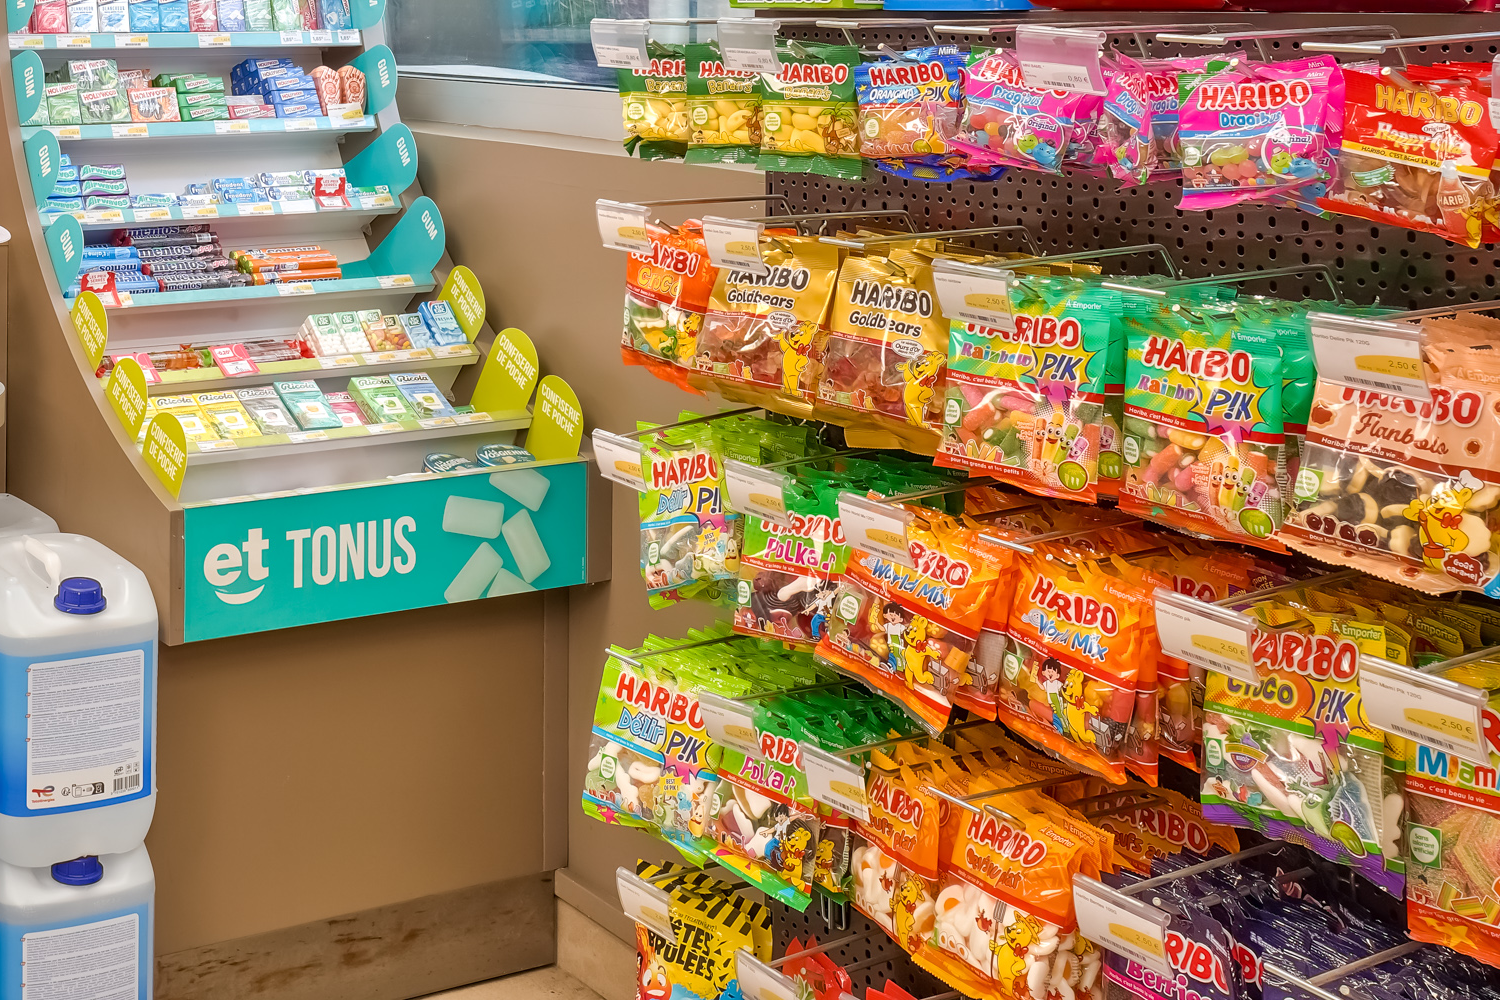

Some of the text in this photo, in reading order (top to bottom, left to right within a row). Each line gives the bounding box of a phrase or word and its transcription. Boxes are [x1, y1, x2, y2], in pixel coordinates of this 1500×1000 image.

[778, 64, 847, 85] HARIBO
[993, 86, 1042, 105] Dragibus
[1199, 81, 1312, 110] HARIBO
[1376, 84, 1482, 125] HARIBO
[1028, 120, 1057, 132] Original
[81, 165, 122, 176] Airwaves
[139, 247, 191, 258] mentos
[728, 290, 794, 309] Goldbears
[852, 281, 932, 316] HARIBO
[850, 311, 921, 337] Goldbears
[499, 334, 536, 381] CONFISERIE
[961, 342, 1032, 367] Rainbow
[1388, 360, 1418, 372] 2,50 €
[496, 350, 525, 390] DE POCHE
[199, 392, 235, 402] Ricola
[204, 516, 417, 589] et TONUS
[1030, 577, 1118, 634] HARIBO
[1039, 612, 1108, 661] World Mix
[1344, 625, 1382, 639] Emporter
[1441, 718, 1462, 731] 2,50
